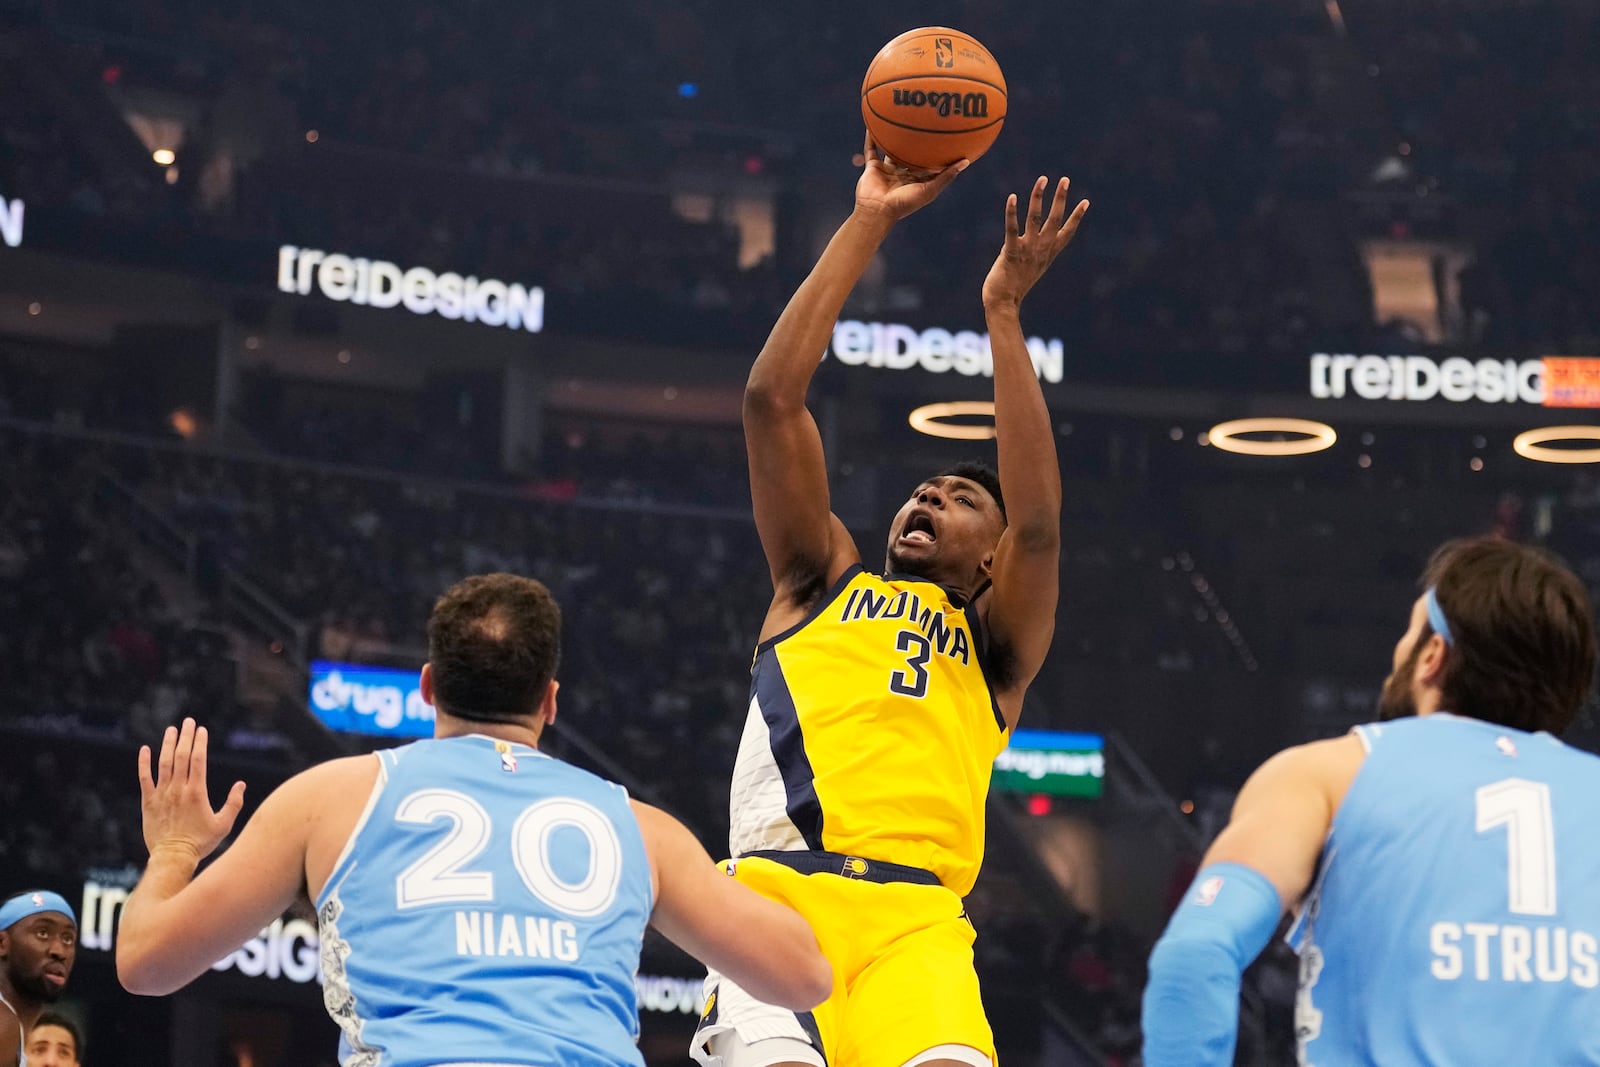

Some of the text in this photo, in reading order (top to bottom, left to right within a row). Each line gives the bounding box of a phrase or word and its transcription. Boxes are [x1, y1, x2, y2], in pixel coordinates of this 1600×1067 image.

[893, 88, 988, 118] Wilson
[841, 588, 969, 666] INDIANA
[890, 630, 931, 699] 3
[311, 670, 404, 729] drug
[394, 788, 622, 917] 20
[1475, 777, 1557, 915] 1
[455, 911, 579, 962] NIANG
[1430, 921, 1599, 989] STRUS
